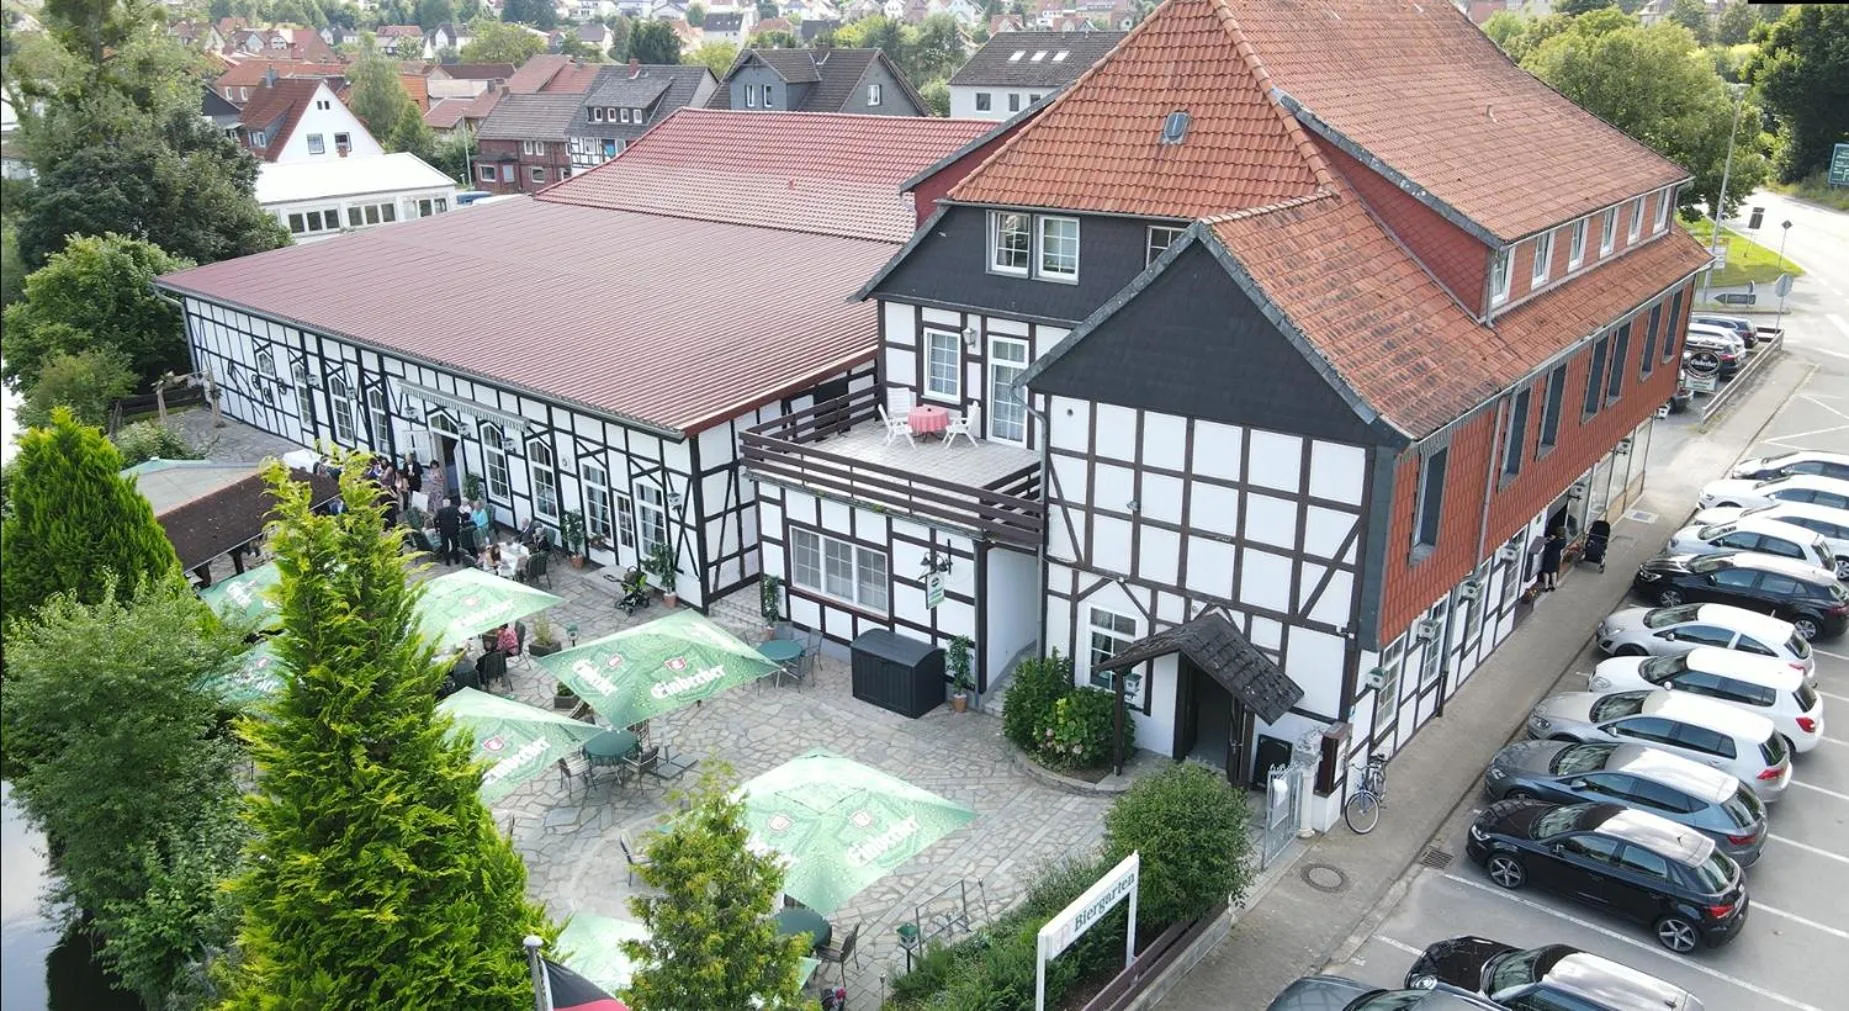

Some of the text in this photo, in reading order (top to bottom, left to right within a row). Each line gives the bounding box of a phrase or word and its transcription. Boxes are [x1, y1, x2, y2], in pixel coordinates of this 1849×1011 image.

[650, 664, 726, 699] Einbecker
[846, 814, 922, 867] Einbecker
[1074, 872, 1136, 933] Biergarten
